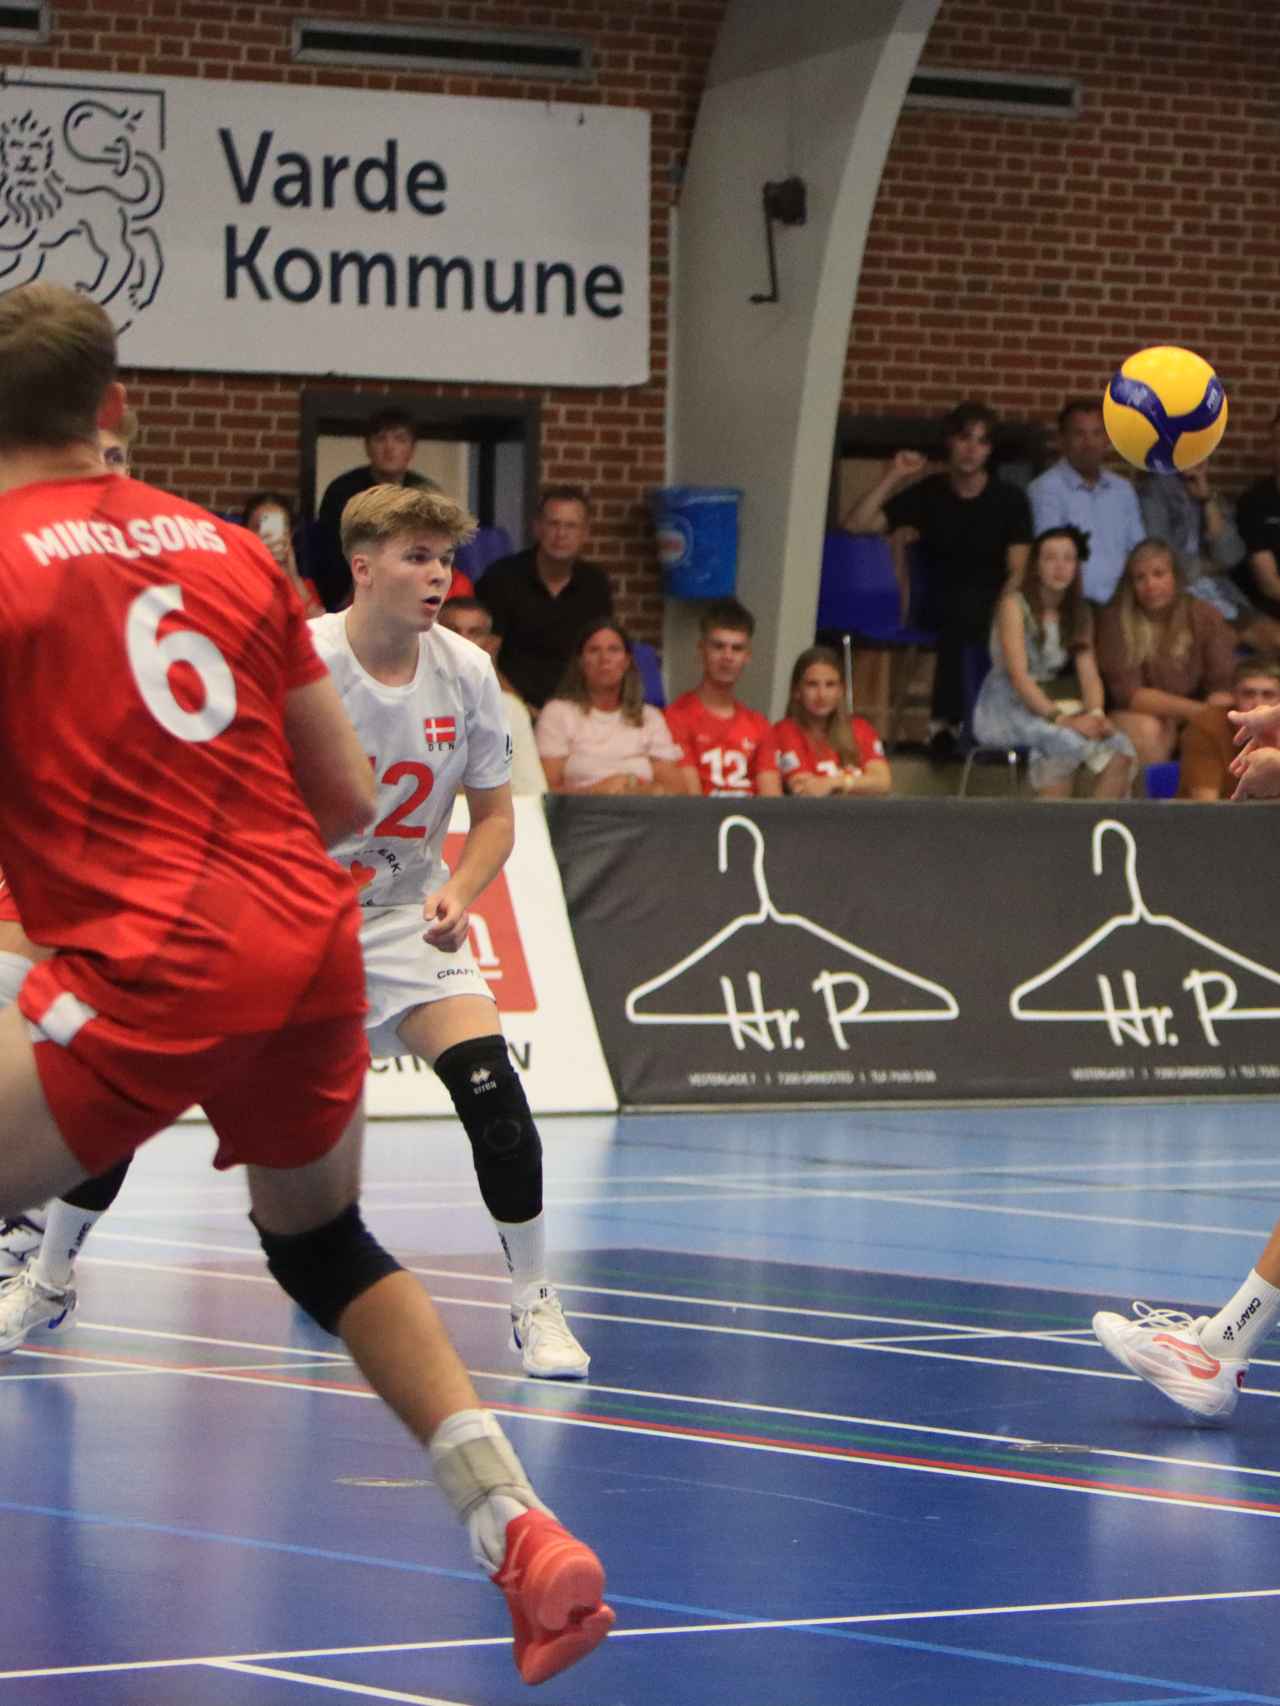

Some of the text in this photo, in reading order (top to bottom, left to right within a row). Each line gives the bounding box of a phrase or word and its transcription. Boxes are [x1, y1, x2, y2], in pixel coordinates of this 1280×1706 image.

[218, 127, 448, 216] Varde
[224, 223, 626, 319] Kommune
[22, 514, 228, 567] MIKELSONS
[125, 583, 237, 742] 6
[701, 748, 751, 787] 12
[720, 969, 870, 1051] Hr. P
[1097, 968, 1238, 1047] Hr. P
[1236, 1297, 1261, 1331] CRAFT
